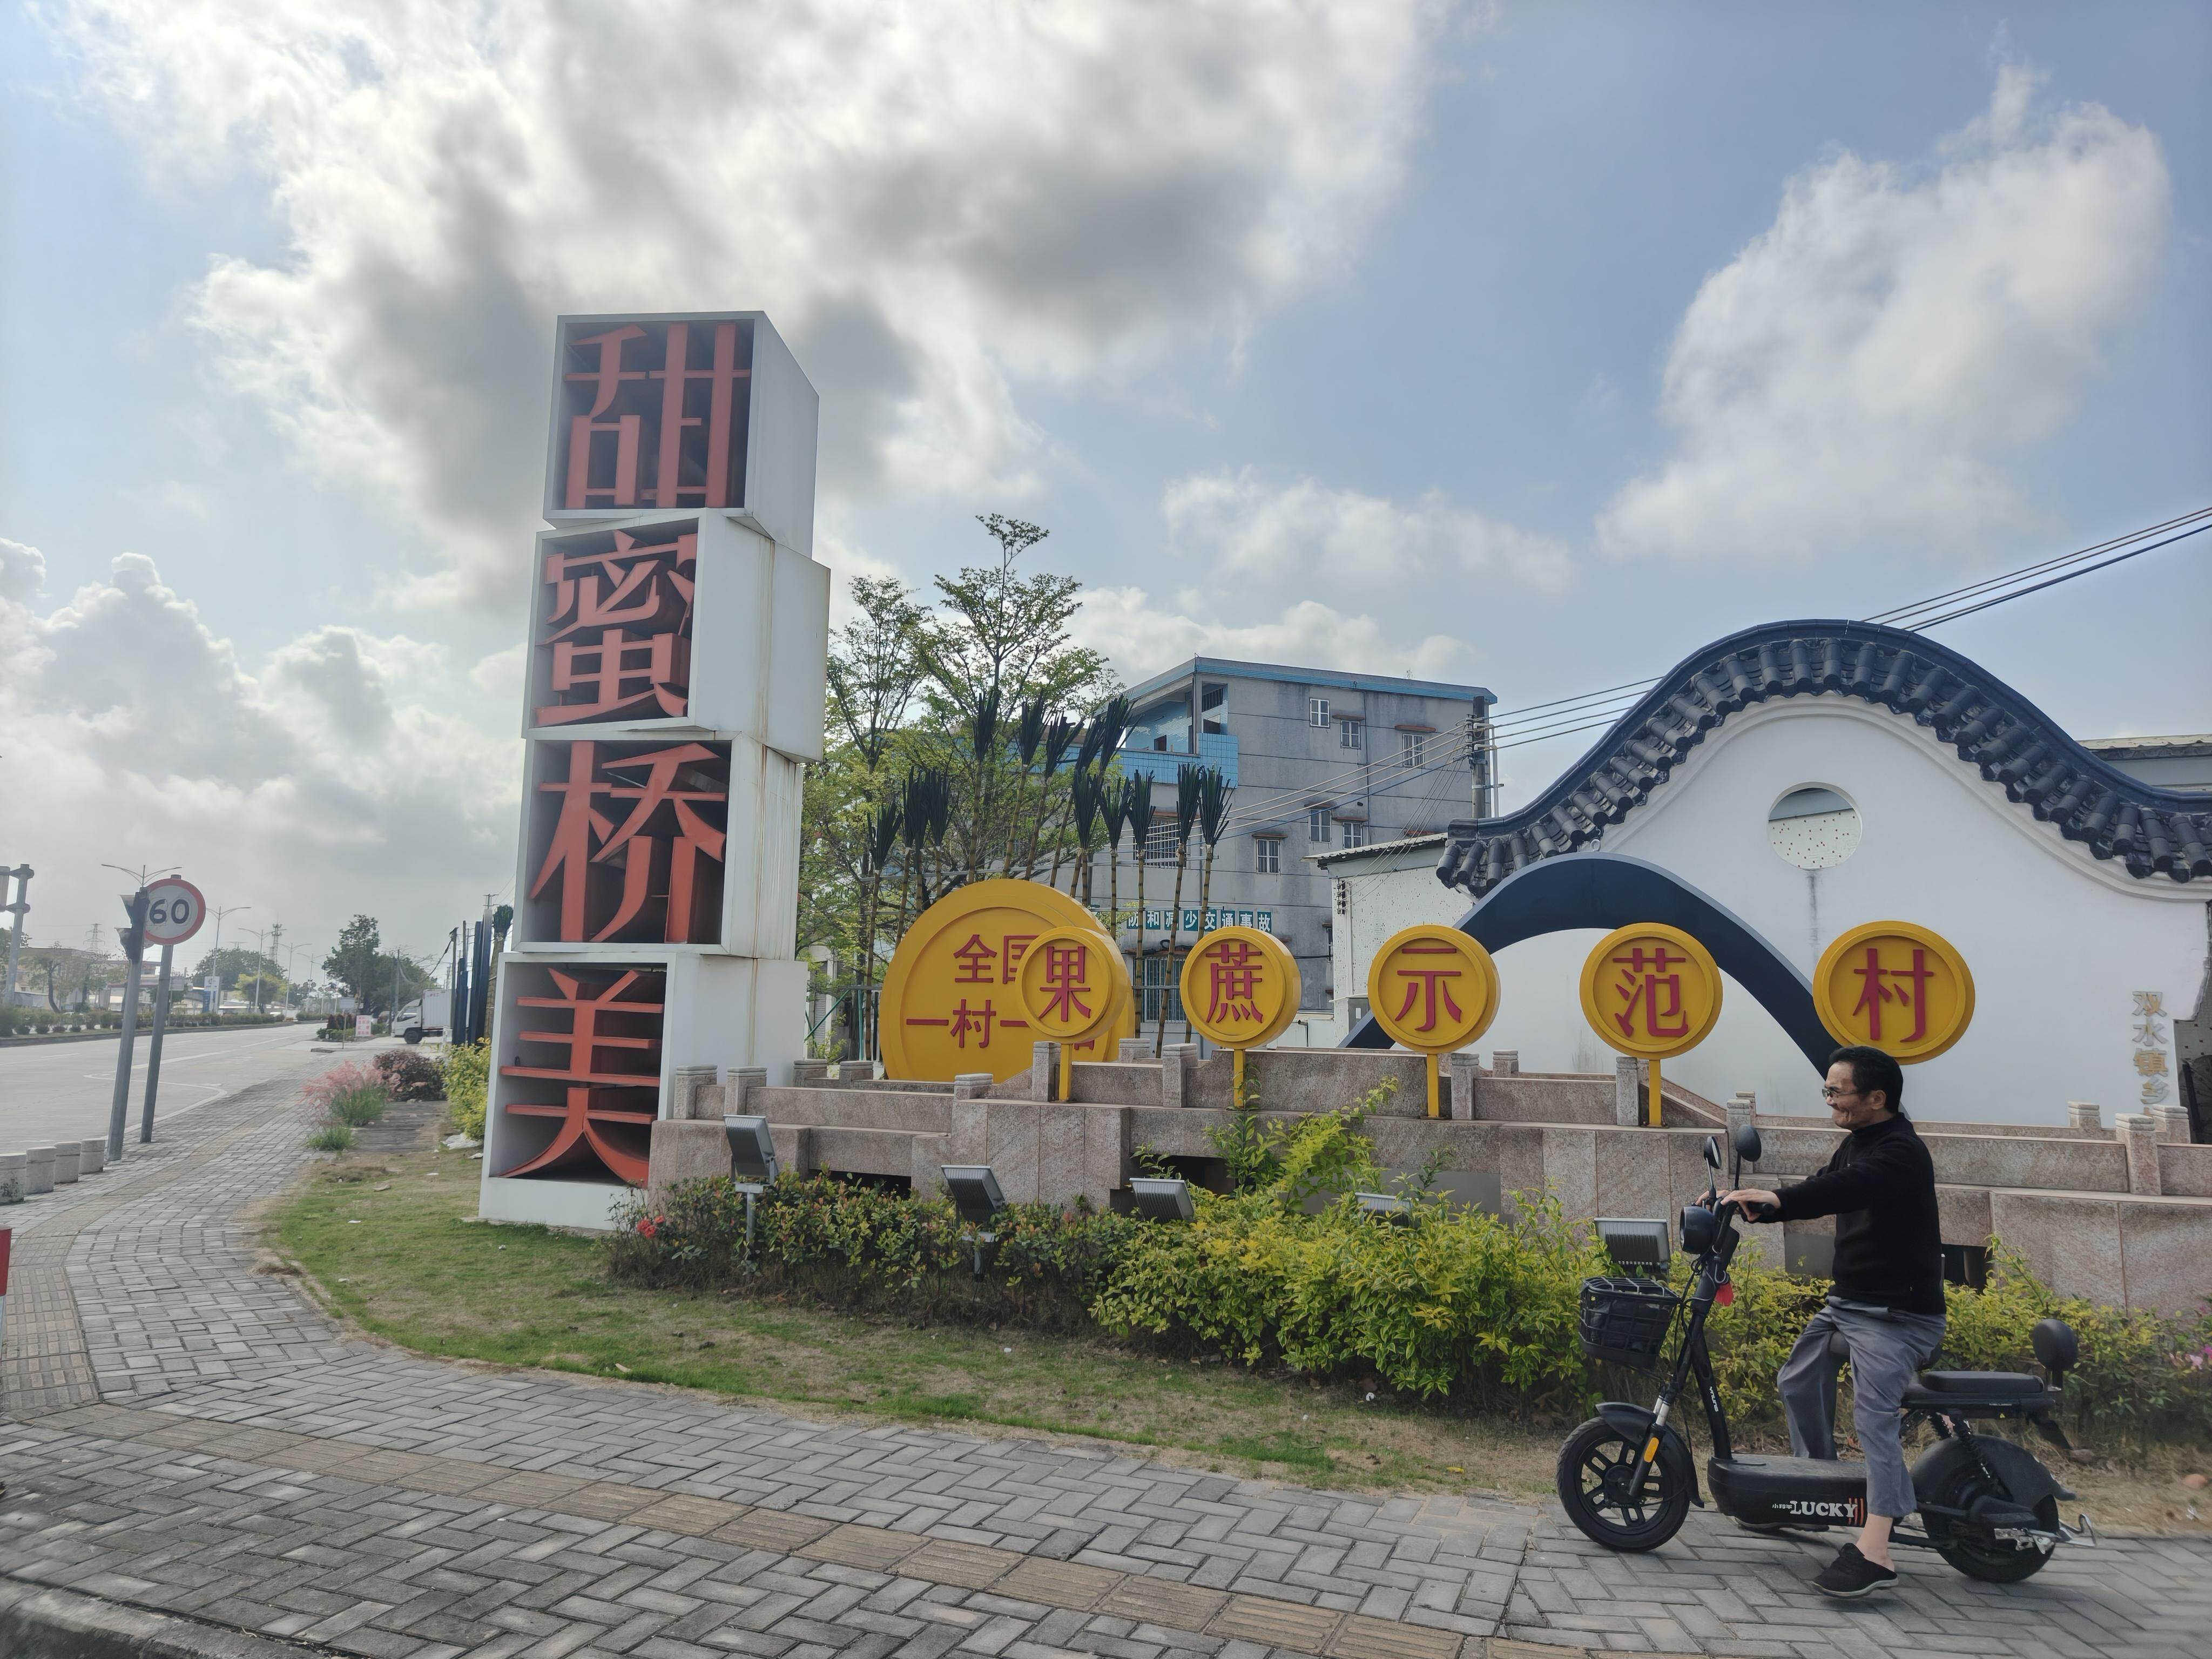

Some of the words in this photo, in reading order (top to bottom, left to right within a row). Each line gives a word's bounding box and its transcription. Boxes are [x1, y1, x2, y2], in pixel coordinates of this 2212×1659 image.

[497, 323, 751, 1189] 甜蜜桥美
[149, 899, 190, 924] 60
[906, 999, 1095, 1050] 一村一
[2132, 991, 2170, 1116] 双水镇乡
[1790, 1500, 1858, 1518] LUCKY
